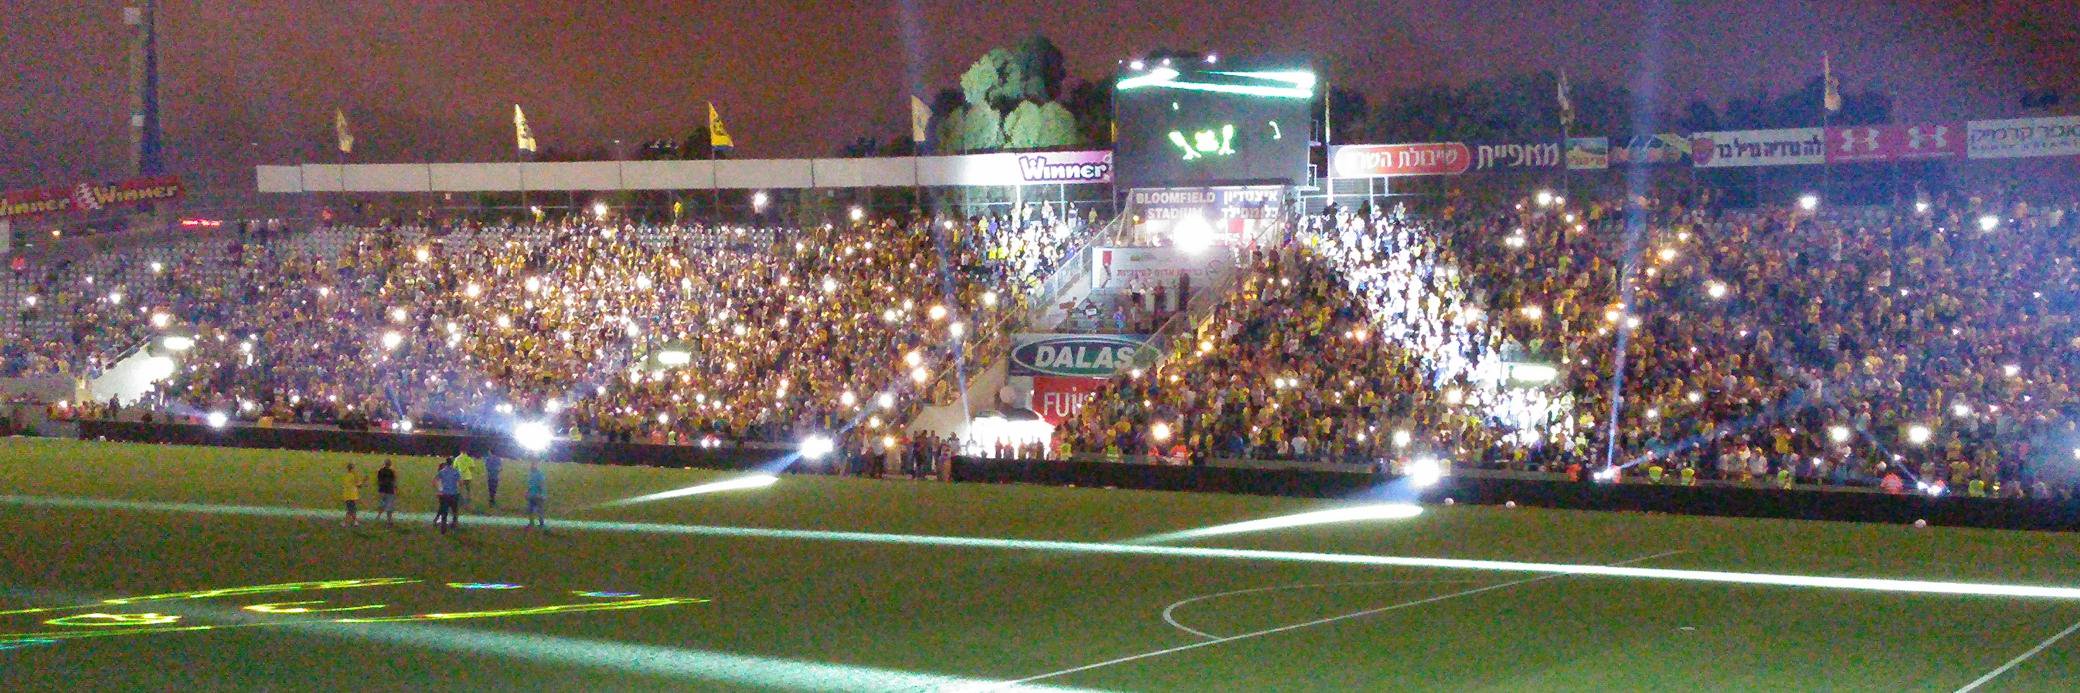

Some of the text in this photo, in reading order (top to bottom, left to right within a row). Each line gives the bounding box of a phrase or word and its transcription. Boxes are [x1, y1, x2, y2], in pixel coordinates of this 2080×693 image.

[1018, 155, 1109, 181] Winner
[1477, 143, 1560, 169] מאפיית
[1136, 191, 1216, 204] BLOOMFIELD
[1147, 207, 1203, 220] STADIUM
[1035, 345, 1136, 369] DALAS
